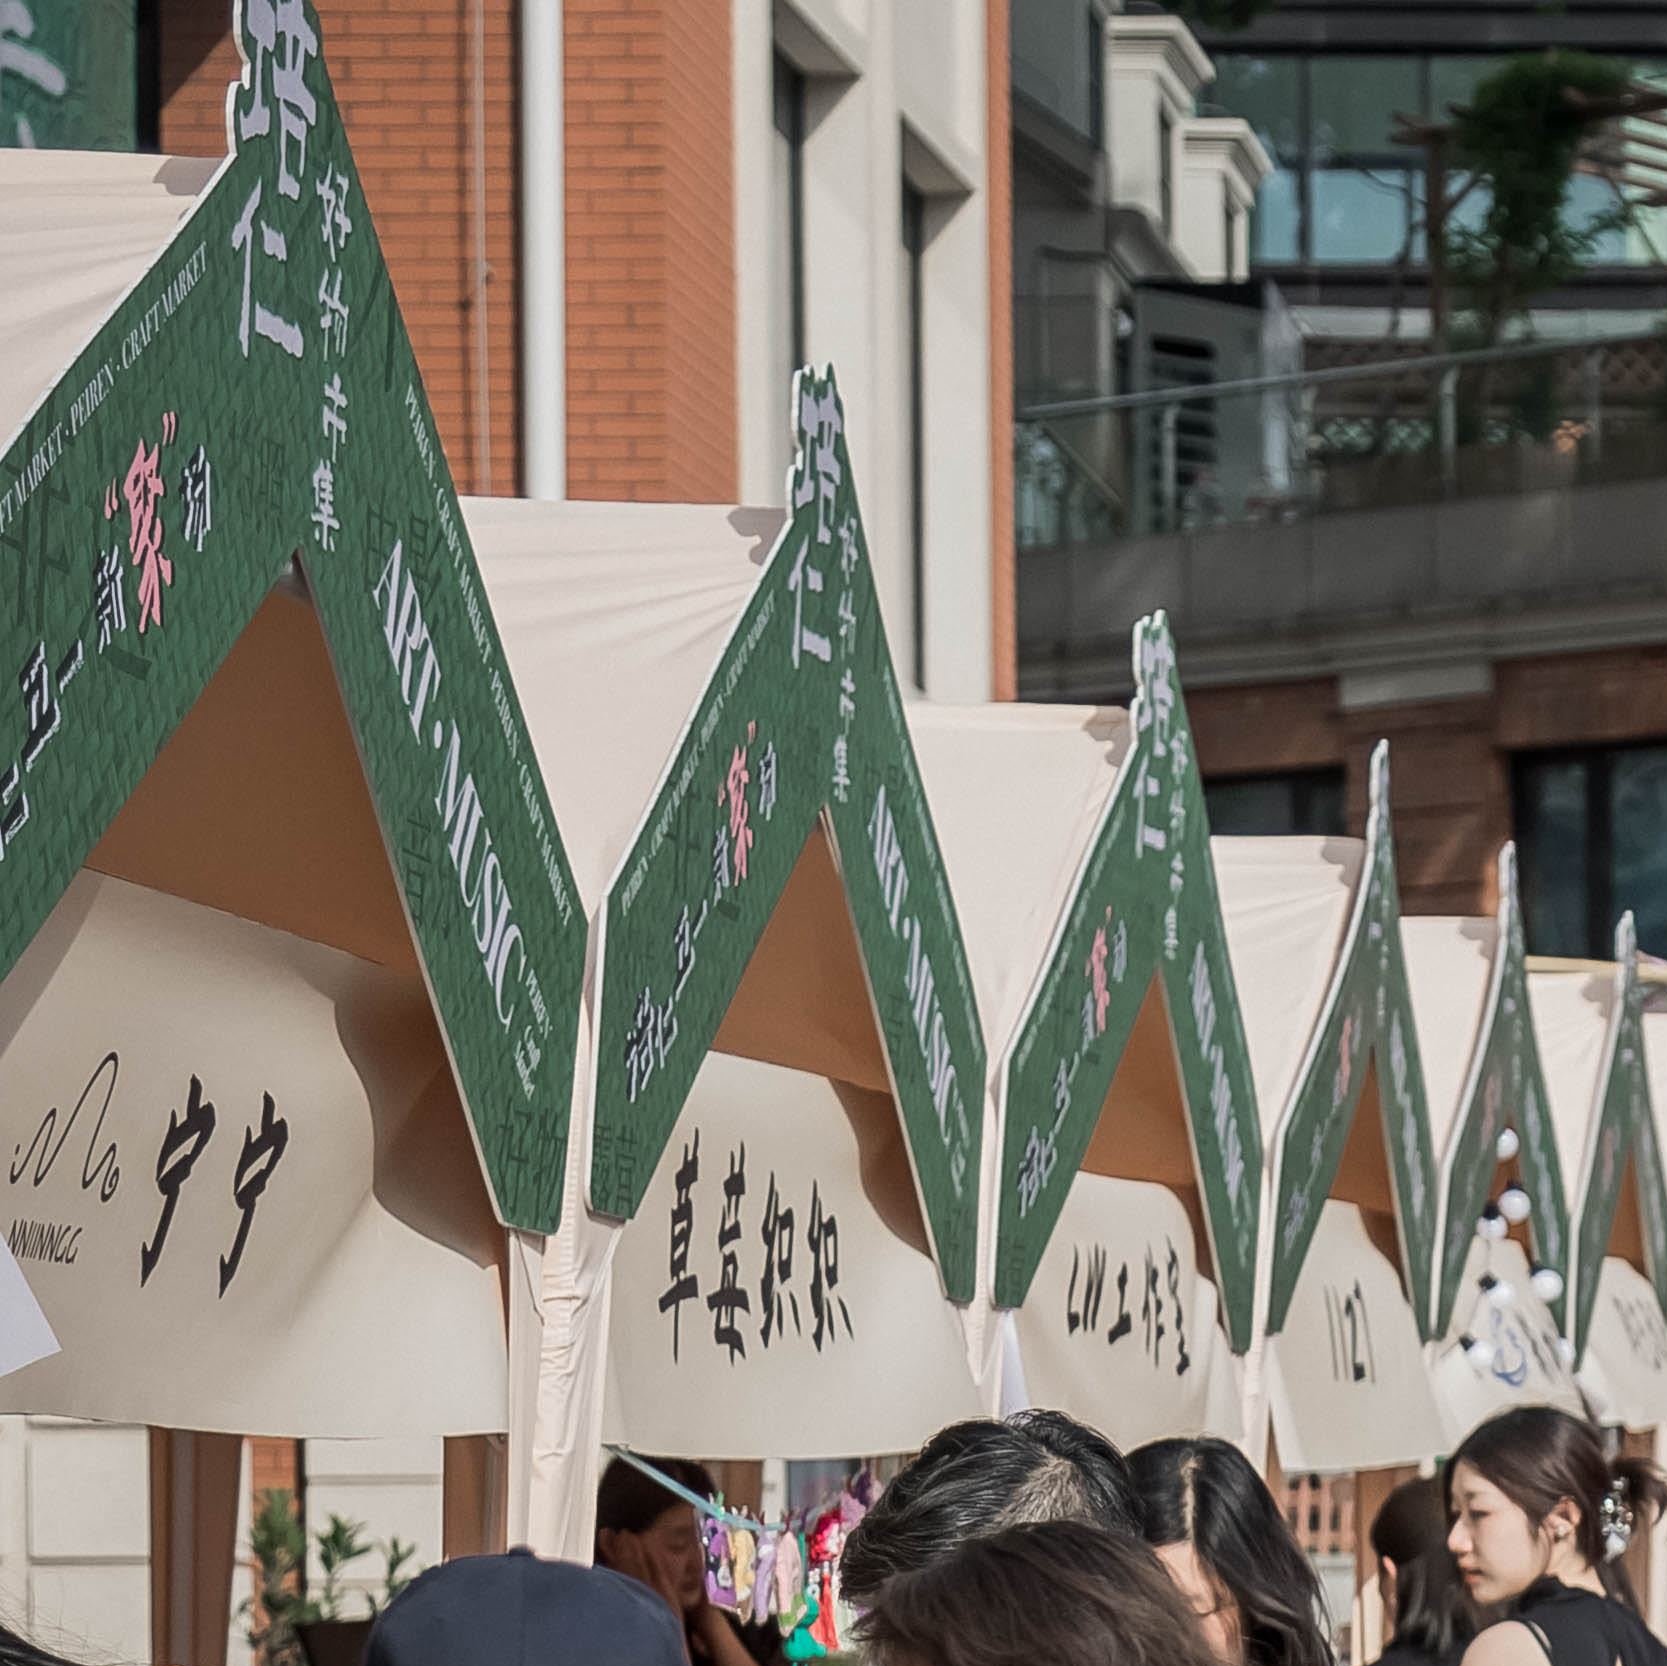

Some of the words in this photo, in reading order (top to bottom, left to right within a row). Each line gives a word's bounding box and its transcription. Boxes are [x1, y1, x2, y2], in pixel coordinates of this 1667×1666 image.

[13, 422, 62, 511] MARKET
[69, 357, 116, 437] PEIREN
[121, 300, 161, 371] CRAFT
[161, 241, 207, 317] MARKET
[311, 160, 352, 552] 好物市集
[373, 538, 441, 745] ART
[434, 719, 527, 1034] MUSIC
[867, 784, 909, 936] ART
